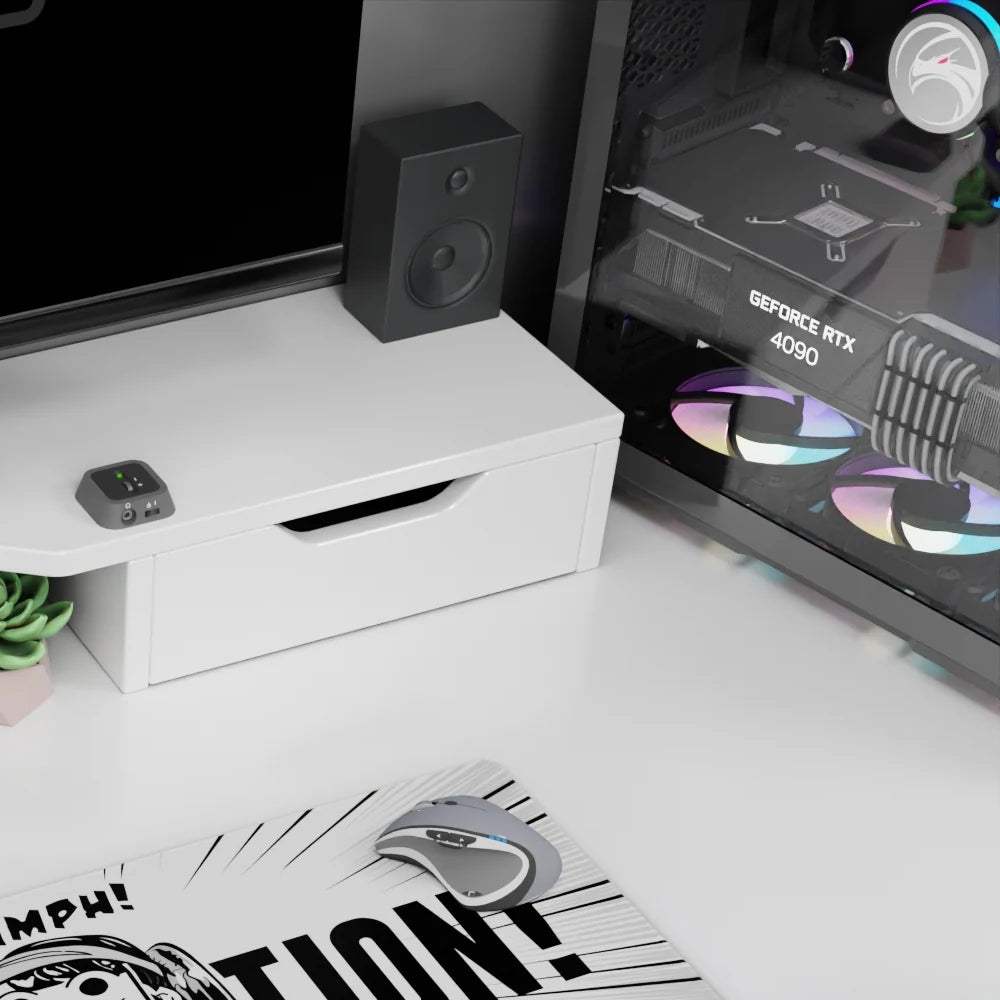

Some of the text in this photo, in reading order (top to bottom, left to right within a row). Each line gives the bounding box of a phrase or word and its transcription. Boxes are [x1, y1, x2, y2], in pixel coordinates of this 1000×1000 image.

[750, 289, 857, 354] GEFORCE RTX
[770, 332, 819, 367] 4090
